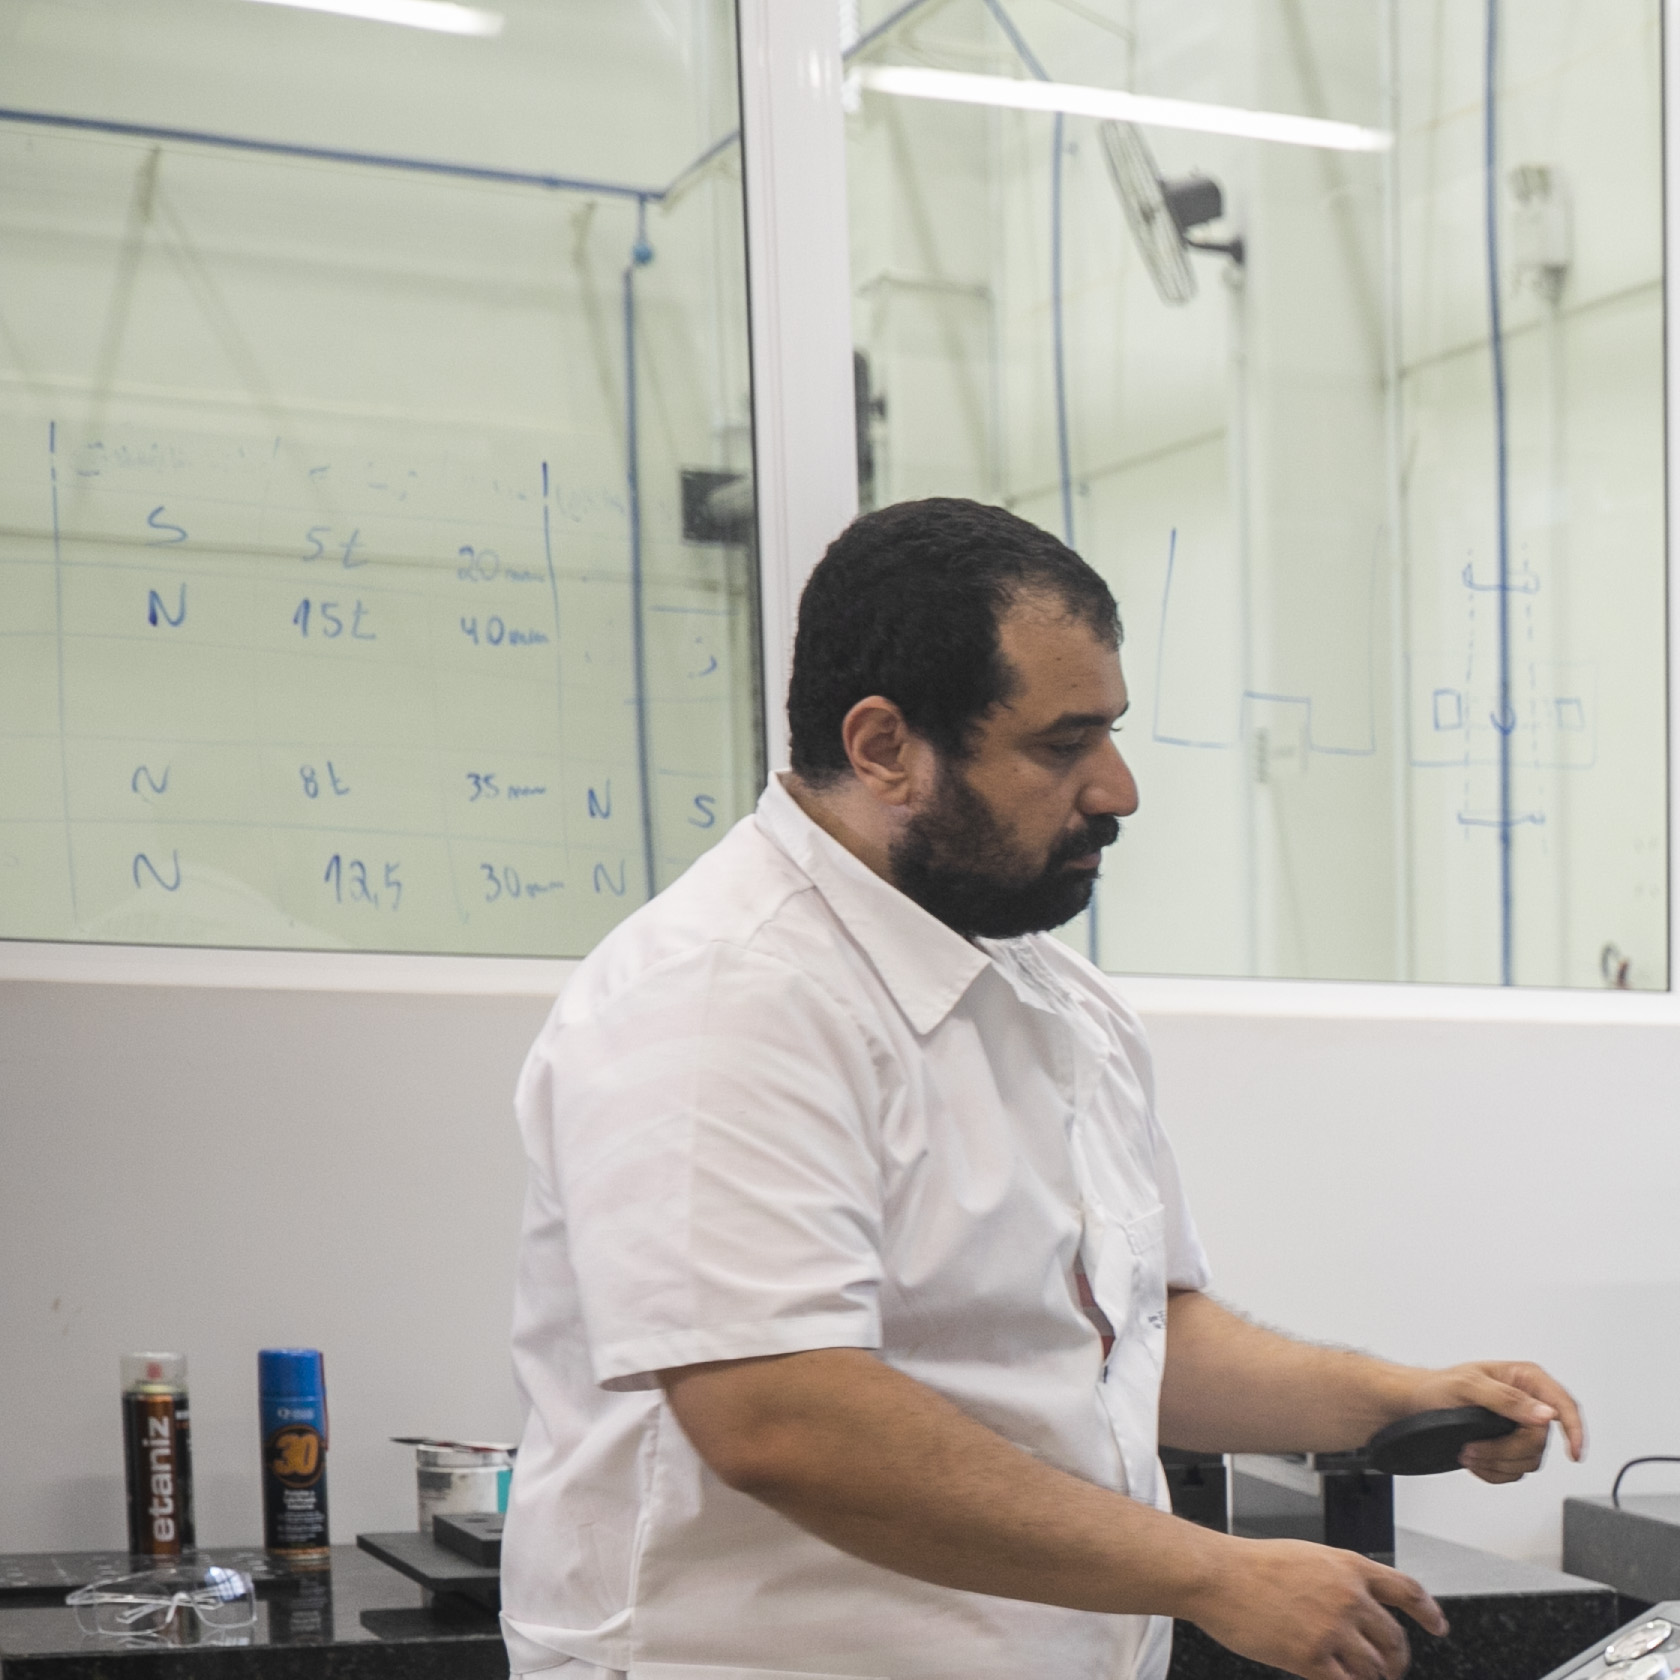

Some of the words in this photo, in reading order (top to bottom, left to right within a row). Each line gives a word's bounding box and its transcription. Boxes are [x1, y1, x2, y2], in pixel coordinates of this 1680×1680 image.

[147, 505, 188, 546] S
[147, 582, 188, 628] N
[588, 779, 612, 819] N
[688, 794, 717, 828] S
[131, 850, 182, 892] N
[594, 860, 627, 899] N
[272, 1433, 319, 1476] 30
[142, 1416, 175, 1542] etaniz
